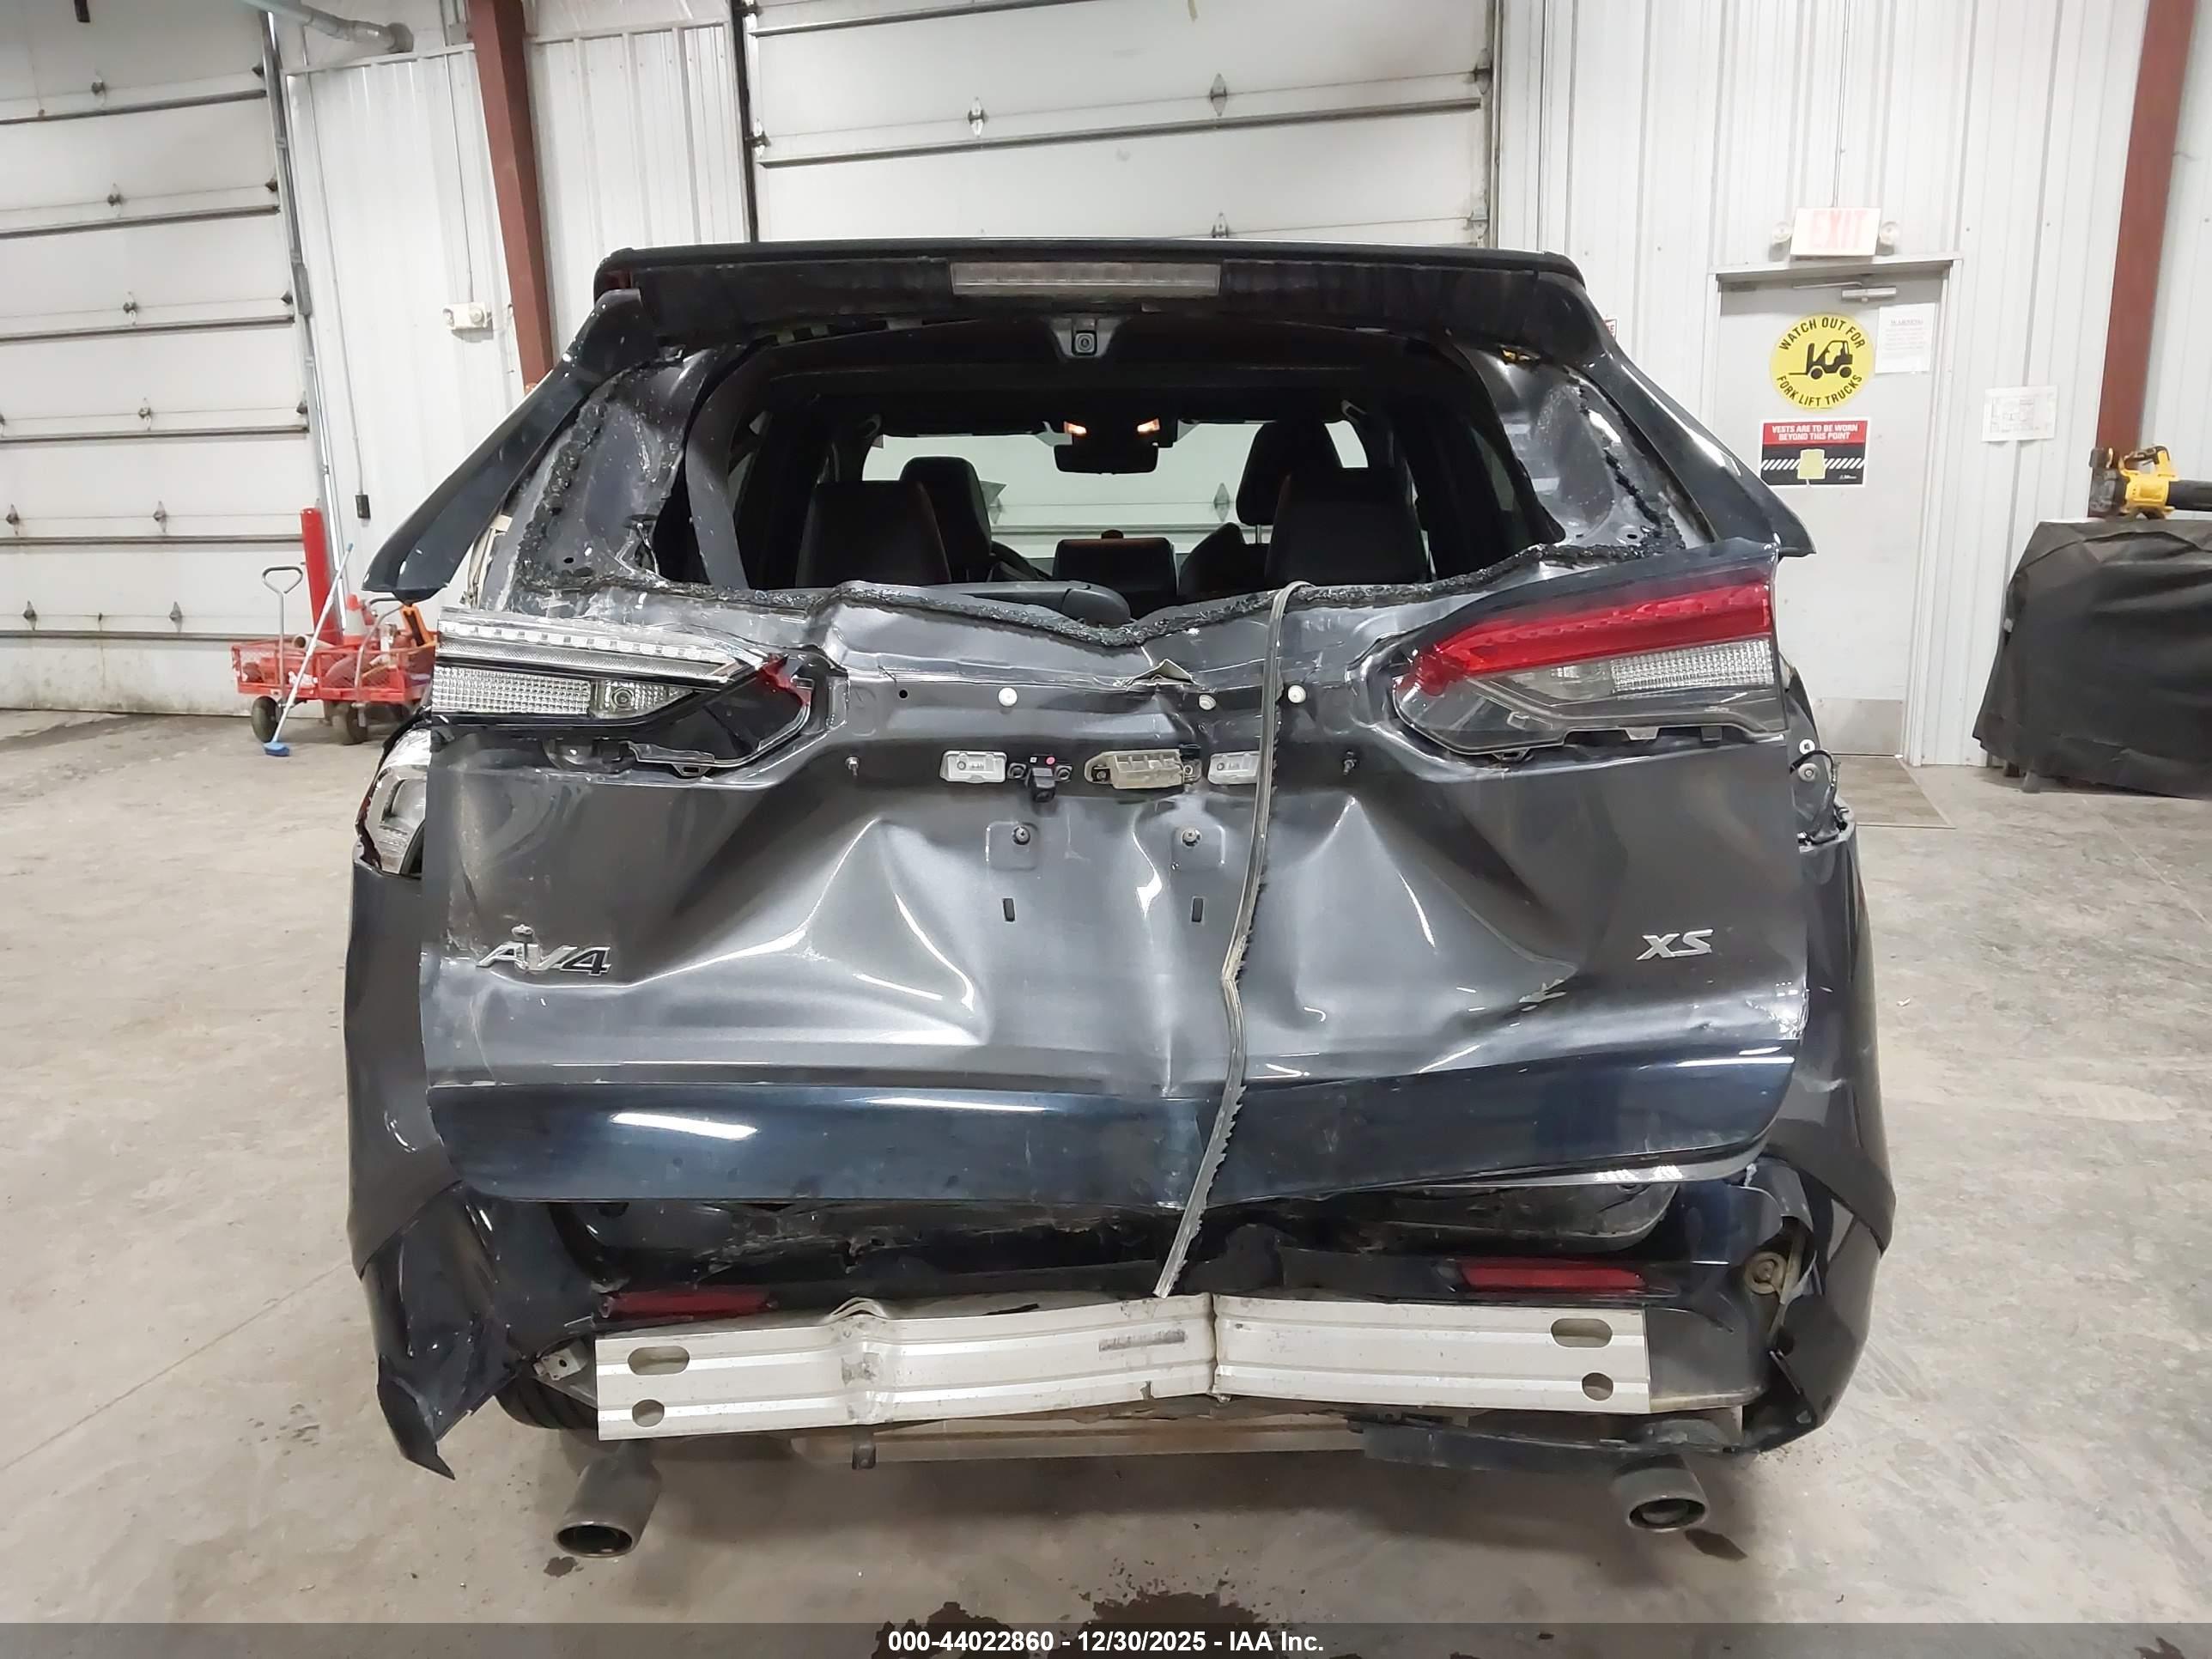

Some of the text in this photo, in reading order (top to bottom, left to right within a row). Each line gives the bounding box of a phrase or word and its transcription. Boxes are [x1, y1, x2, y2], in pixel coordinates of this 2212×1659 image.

[1809, 209, 1868, 249] EXIT
[1779, 319, 1817, 350] WATCH
[1821, 317, 1846, 331] OUT
[1845, 326, 1866, 349] FOR
[1777, 374, 1863, 406] FORK LIFT TRUCKS
[1771, 425, 1795, 434] VESTS
[1834, 423, 1858, 432] WORN
[1636, 928, 1714, 961] XS
